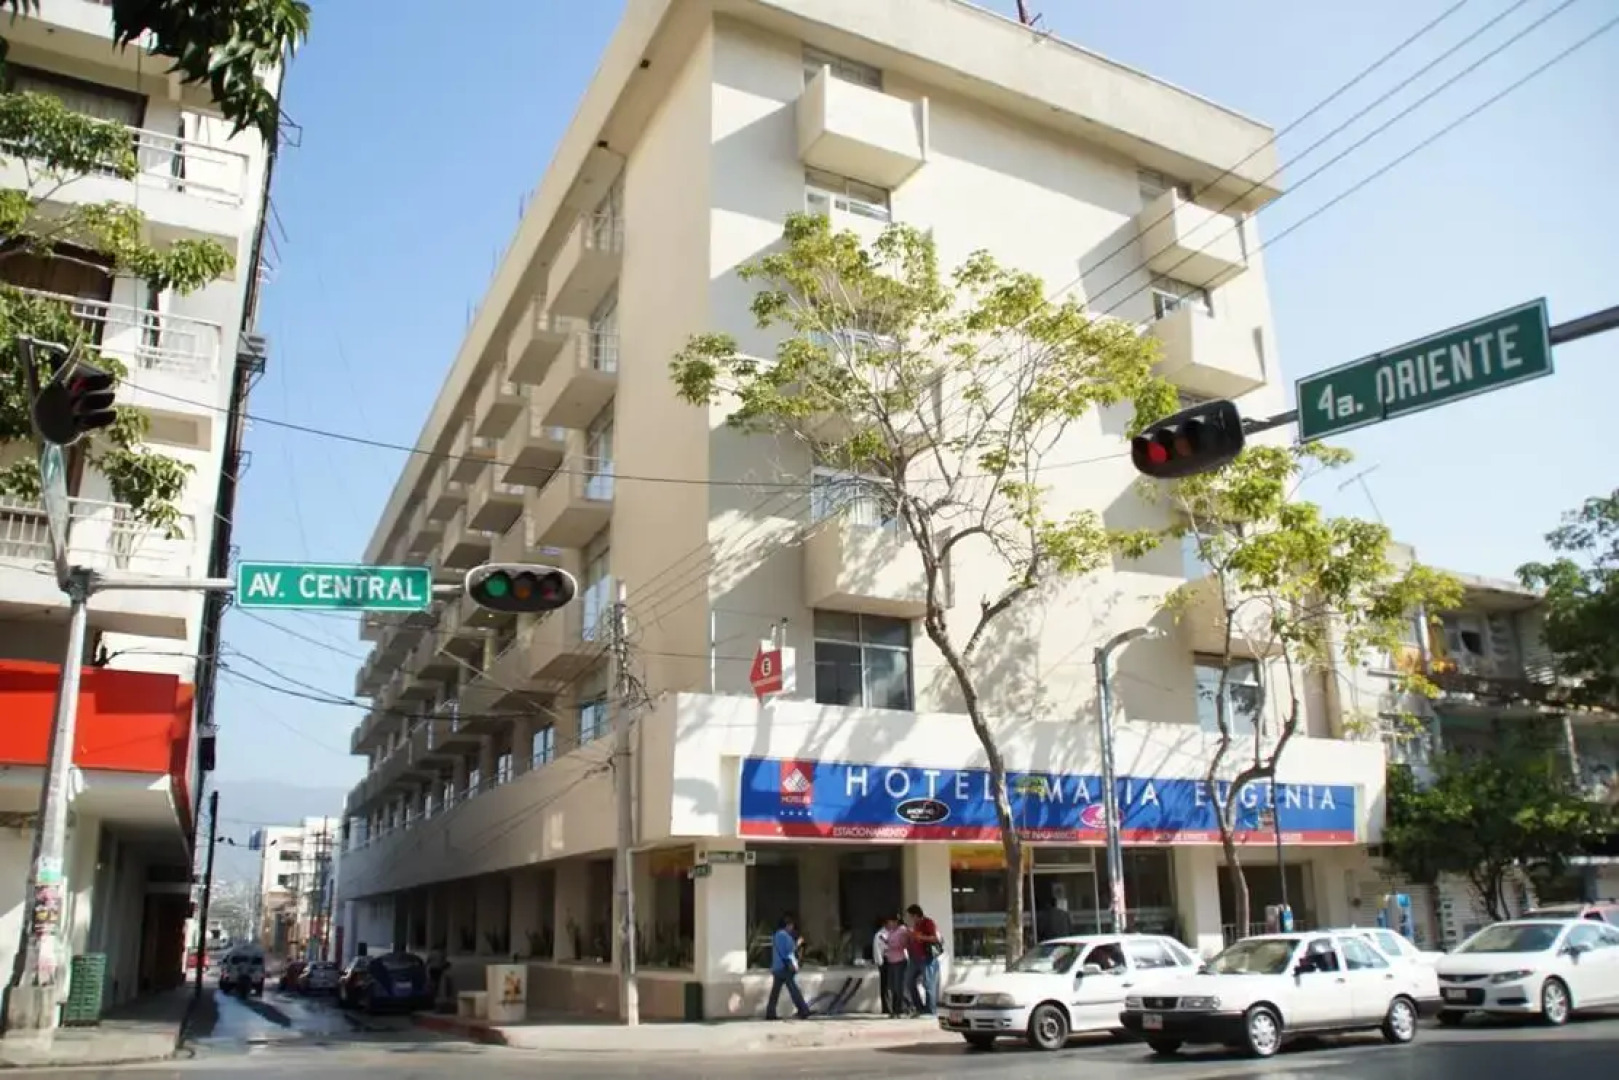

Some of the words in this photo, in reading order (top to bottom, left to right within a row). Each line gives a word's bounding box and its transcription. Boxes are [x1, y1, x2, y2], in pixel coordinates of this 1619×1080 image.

[1317, 384, 1364, 420] 4a.
[1375, 324, 1523, 405] ORIENTE
[248, 572, 285, 598] AV.
[298, 573, 423, 601] CENTRAL
[845, 766, 994, 801] HOTEL
[1040, 776, 1159, 806] MAIA
[1194, 782, 1336, 810] EUGENIA
